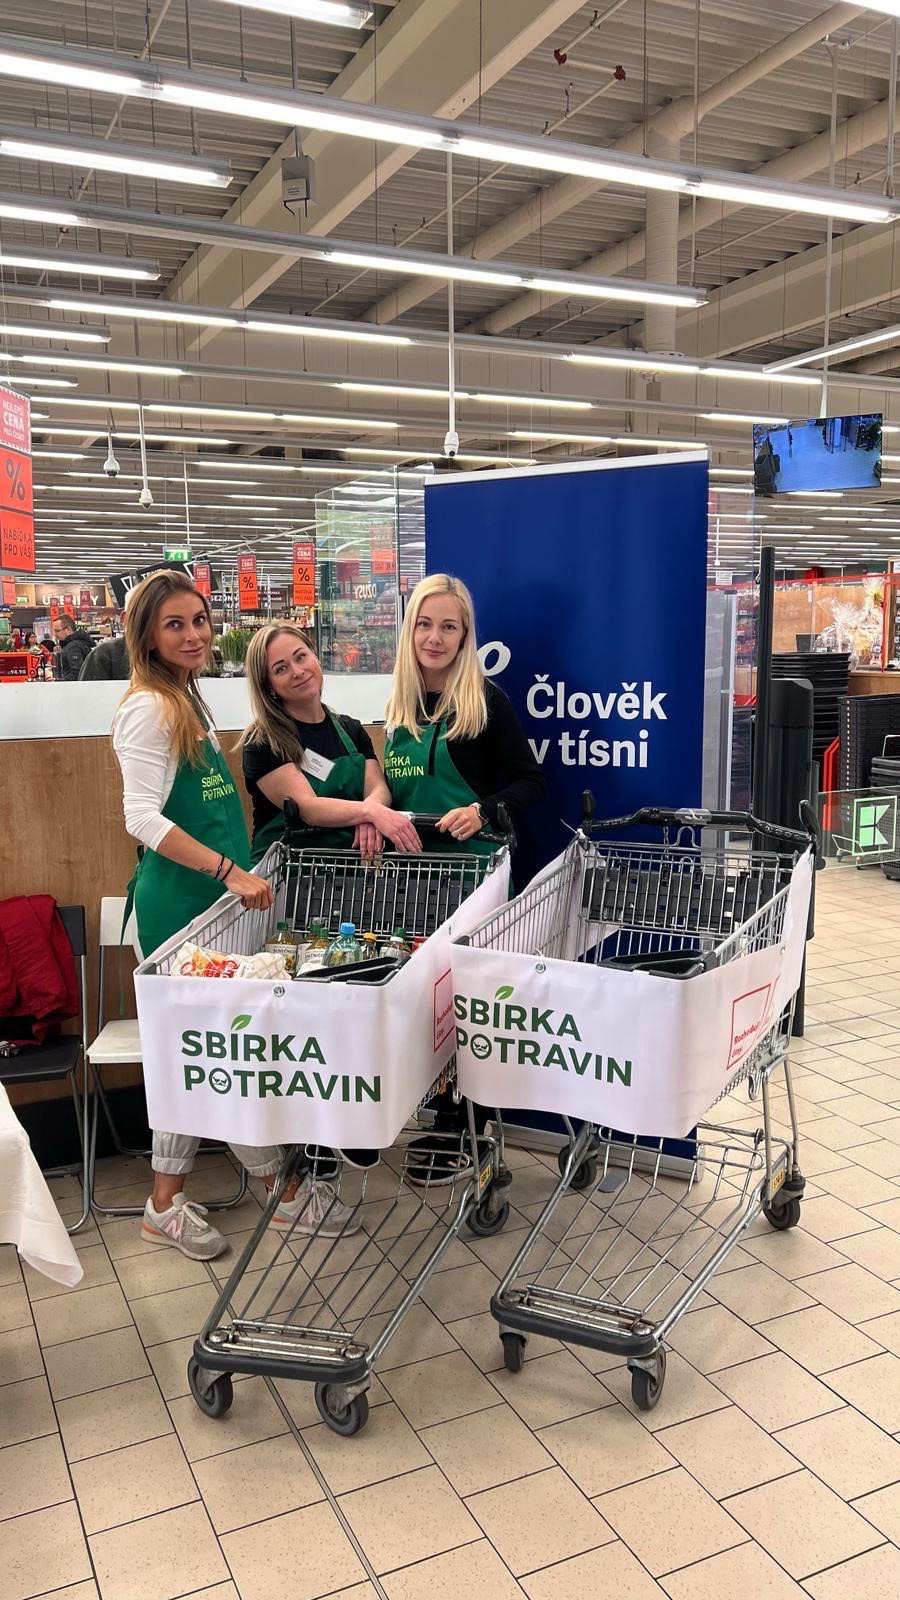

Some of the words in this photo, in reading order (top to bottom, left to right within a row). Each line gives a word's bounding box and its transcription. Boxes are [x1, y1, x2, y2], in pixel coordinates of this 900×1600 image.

[3, 411, 24, 433] CENA
[6, 458, 26, 501] %
[3, 527, 32, 544] NABÍDKA
[4, 543, 17, 556] PRO
[243, 576, 253, 588] %
[298, 568, 310, 581] %
[526, 674, 668, 720] Člověk
[527, 738, 550, 765] v
[558, 729, 649, 769] tísni
[386, 766, 424, 778] TRAVIN
[455, 1025, 632, 1087] POTRAVIN
[183, 1064, 381, 1103] POTRAVIN
